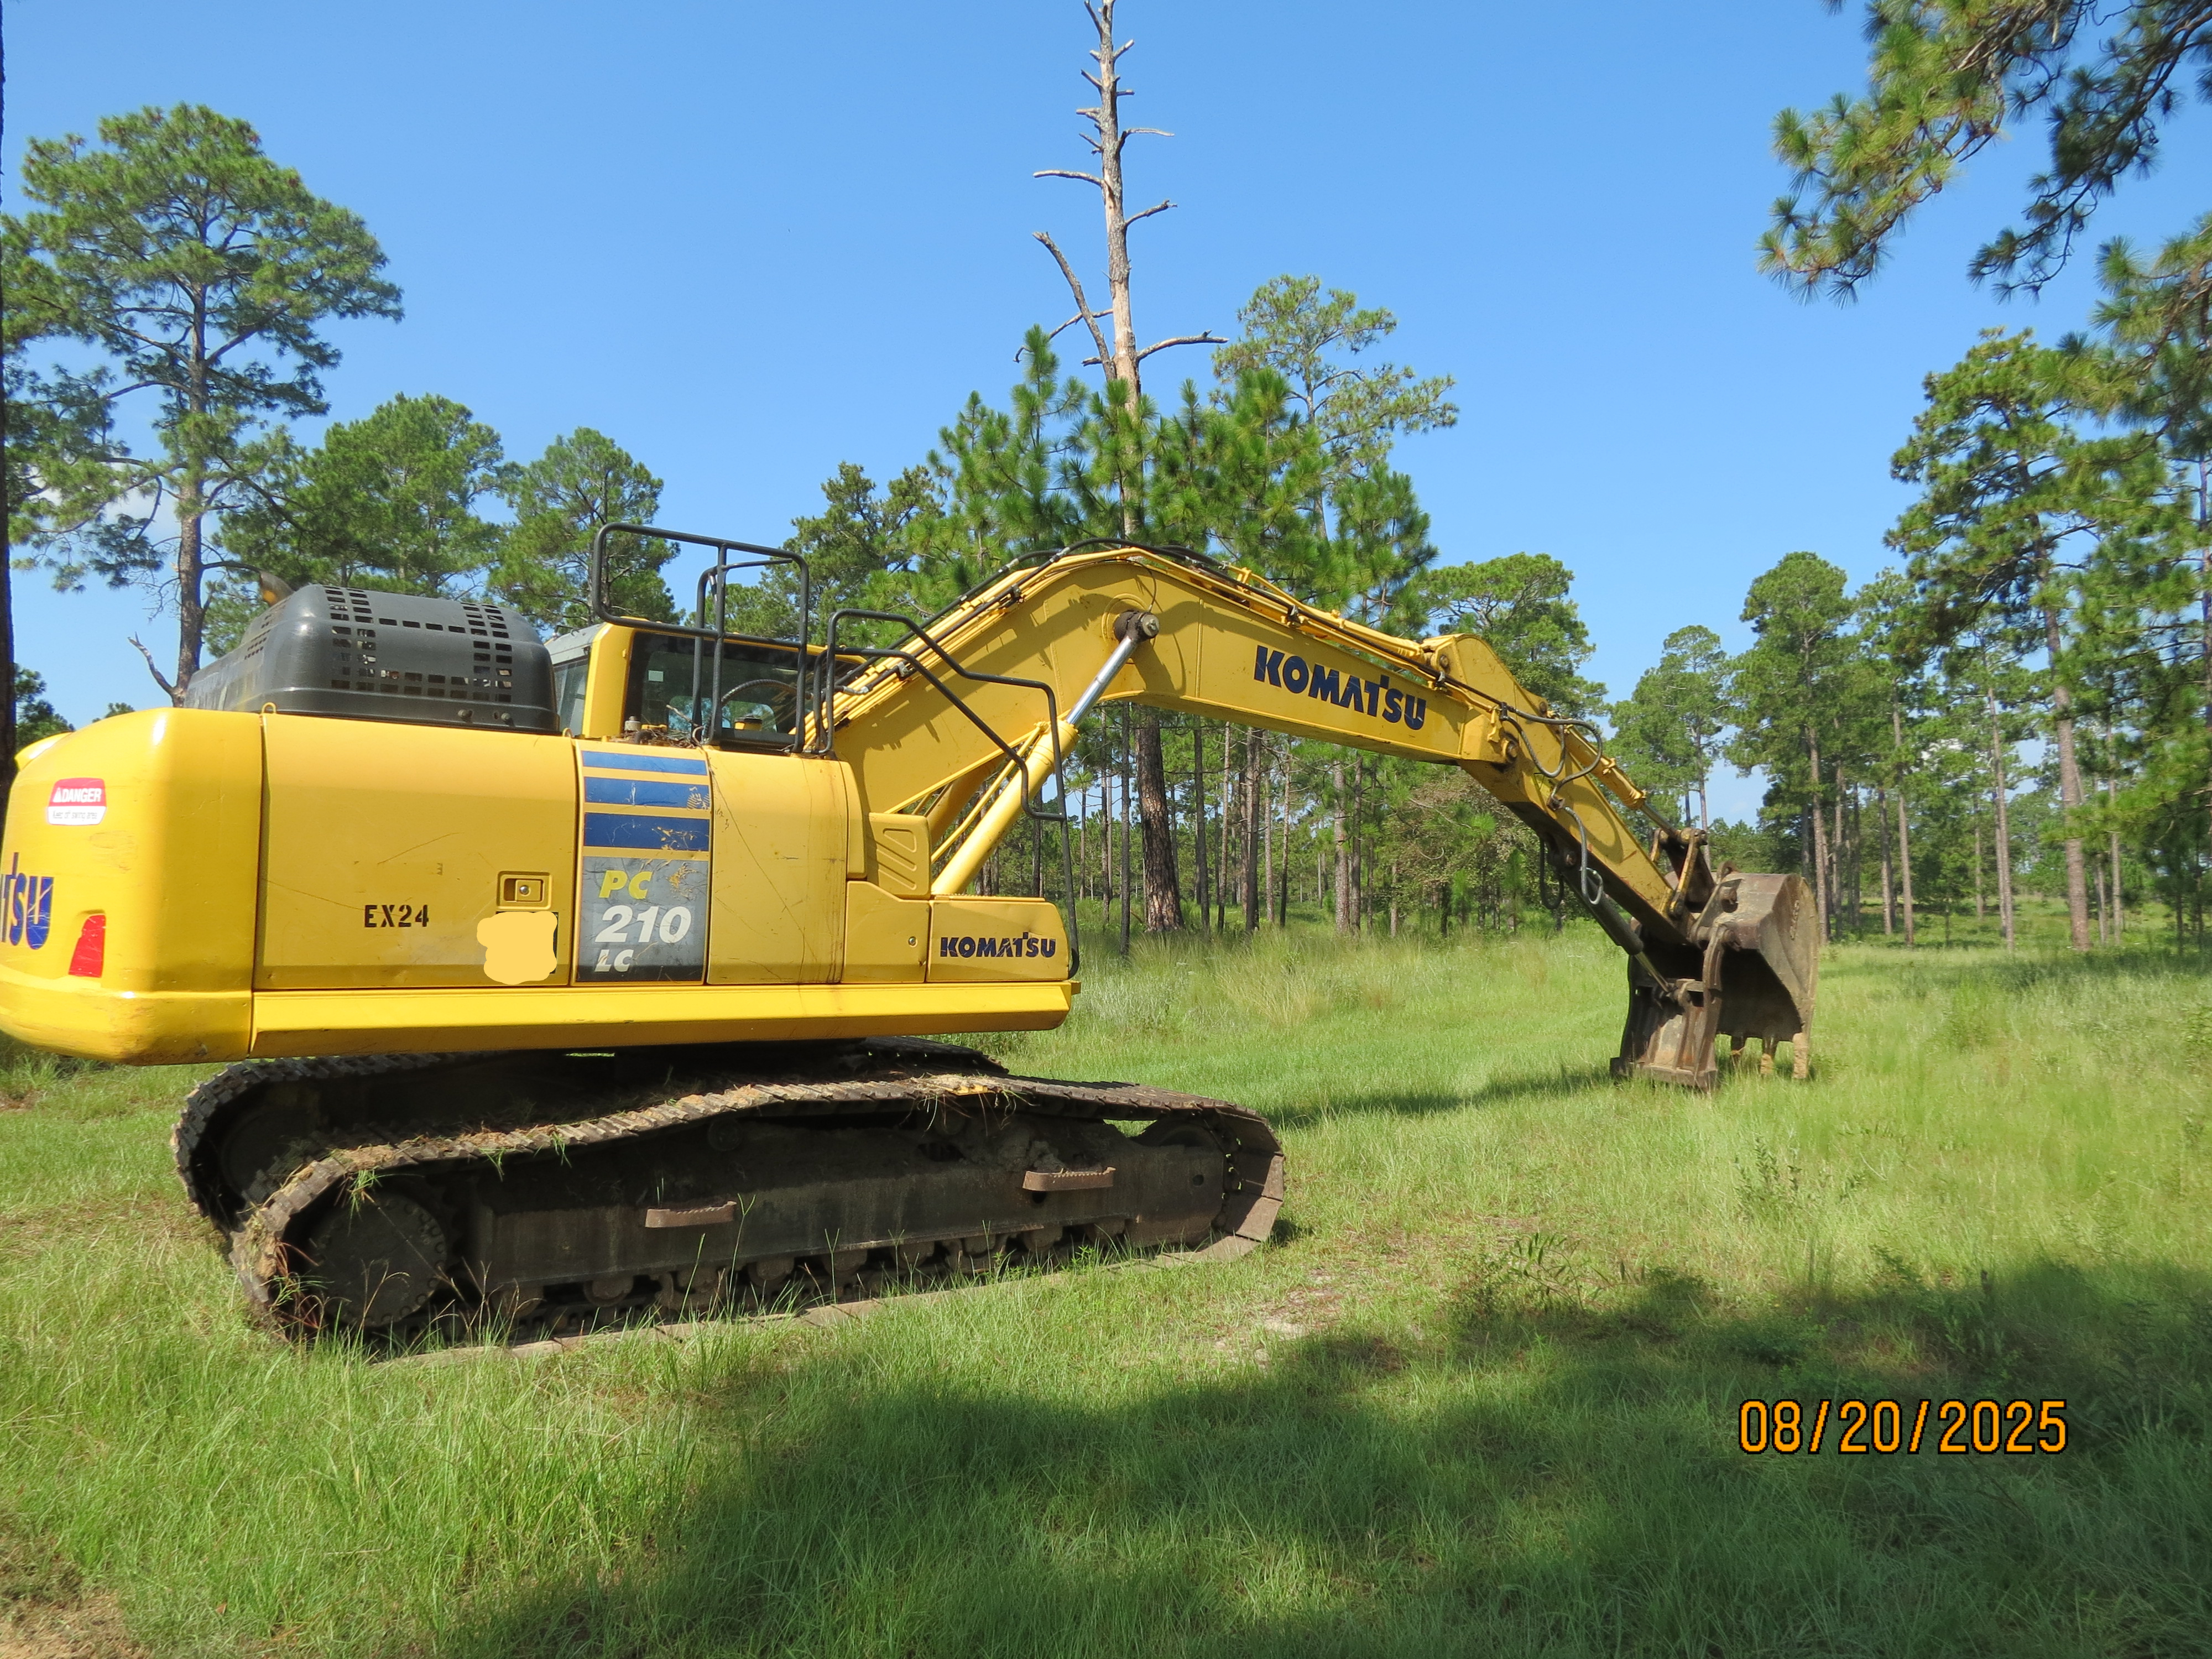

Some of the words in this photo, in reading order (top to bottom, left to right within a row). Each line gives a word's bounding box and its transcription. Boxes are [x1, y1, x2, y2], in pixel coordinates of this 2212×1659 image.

[1254, 645, 1427, 731] KOMATSU
[61, 788, 102, 802] DANGER
[598, 870, 653, 899] PC
[364, 904, 429, 928] EX24
[594, 905, 691, 943] 210
[940, 932, 1056, 958] KOMATSU
[594, 949, 634, 972] LC
